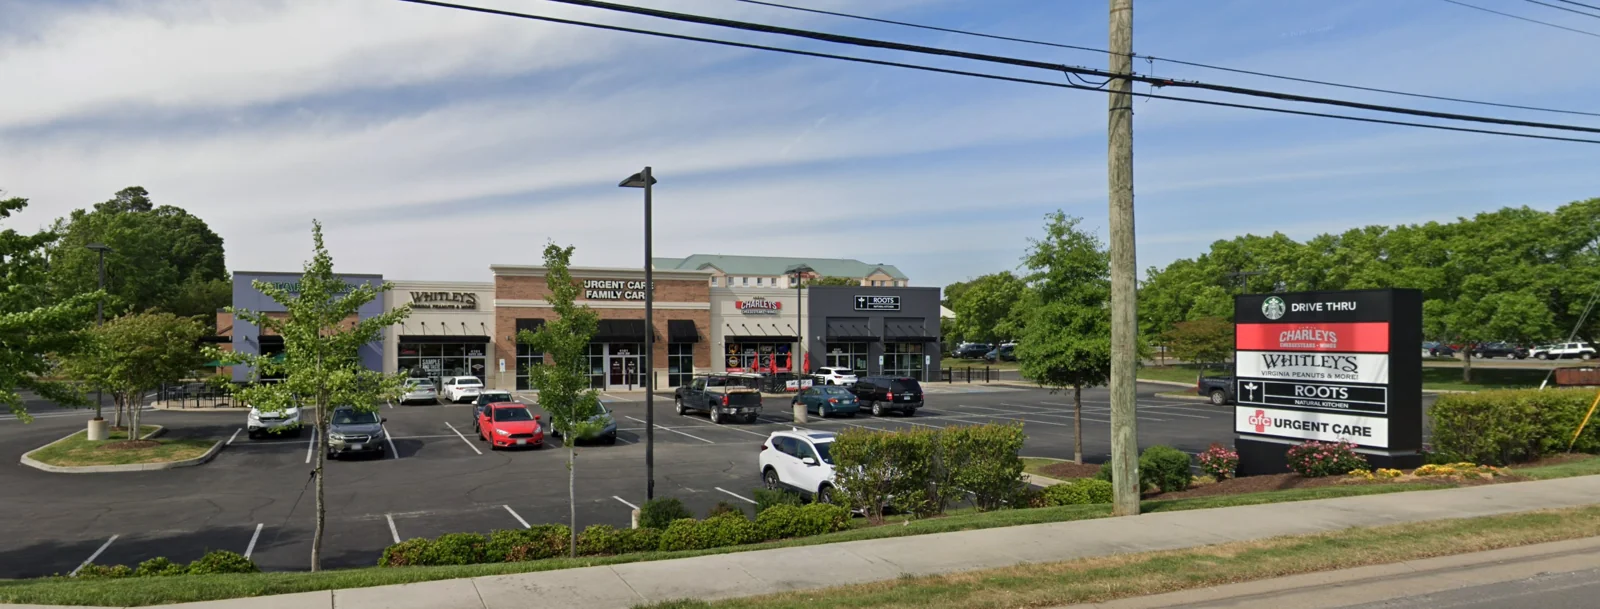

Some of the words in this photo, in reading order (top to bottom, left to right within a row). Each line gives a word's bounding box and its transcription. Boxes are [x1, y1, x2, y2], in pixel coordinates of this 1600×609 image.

[583, 280, 625, 289] URGENT
[627, 281, 654, 290] CAR
[585, 290, 622, 299] FAMILY
[624, 291, 647, 300] CAR
[740, 299, 777, 310] CHARLEYS
[1291, 302, 1323, 312] DRIVE
[1326, 301, 1356, 311] THRU
[1279, 329, 1338, 343] CHARLEYS
[1261, 353, 1359, 374] WHITLEY'S
[1292, 371, 1325, 379] PEANUTS
[1294, 385, 1349, 399] ROOTS
[1294, 399, 1321, 407] NATURAL
[1322, 401, 1349, 409] KITCHEN
[1249, 413, 1272, 426] afc
[1274, 418, 1329, 433] URGENT
[1331, 424, 1372, 437] CARE
